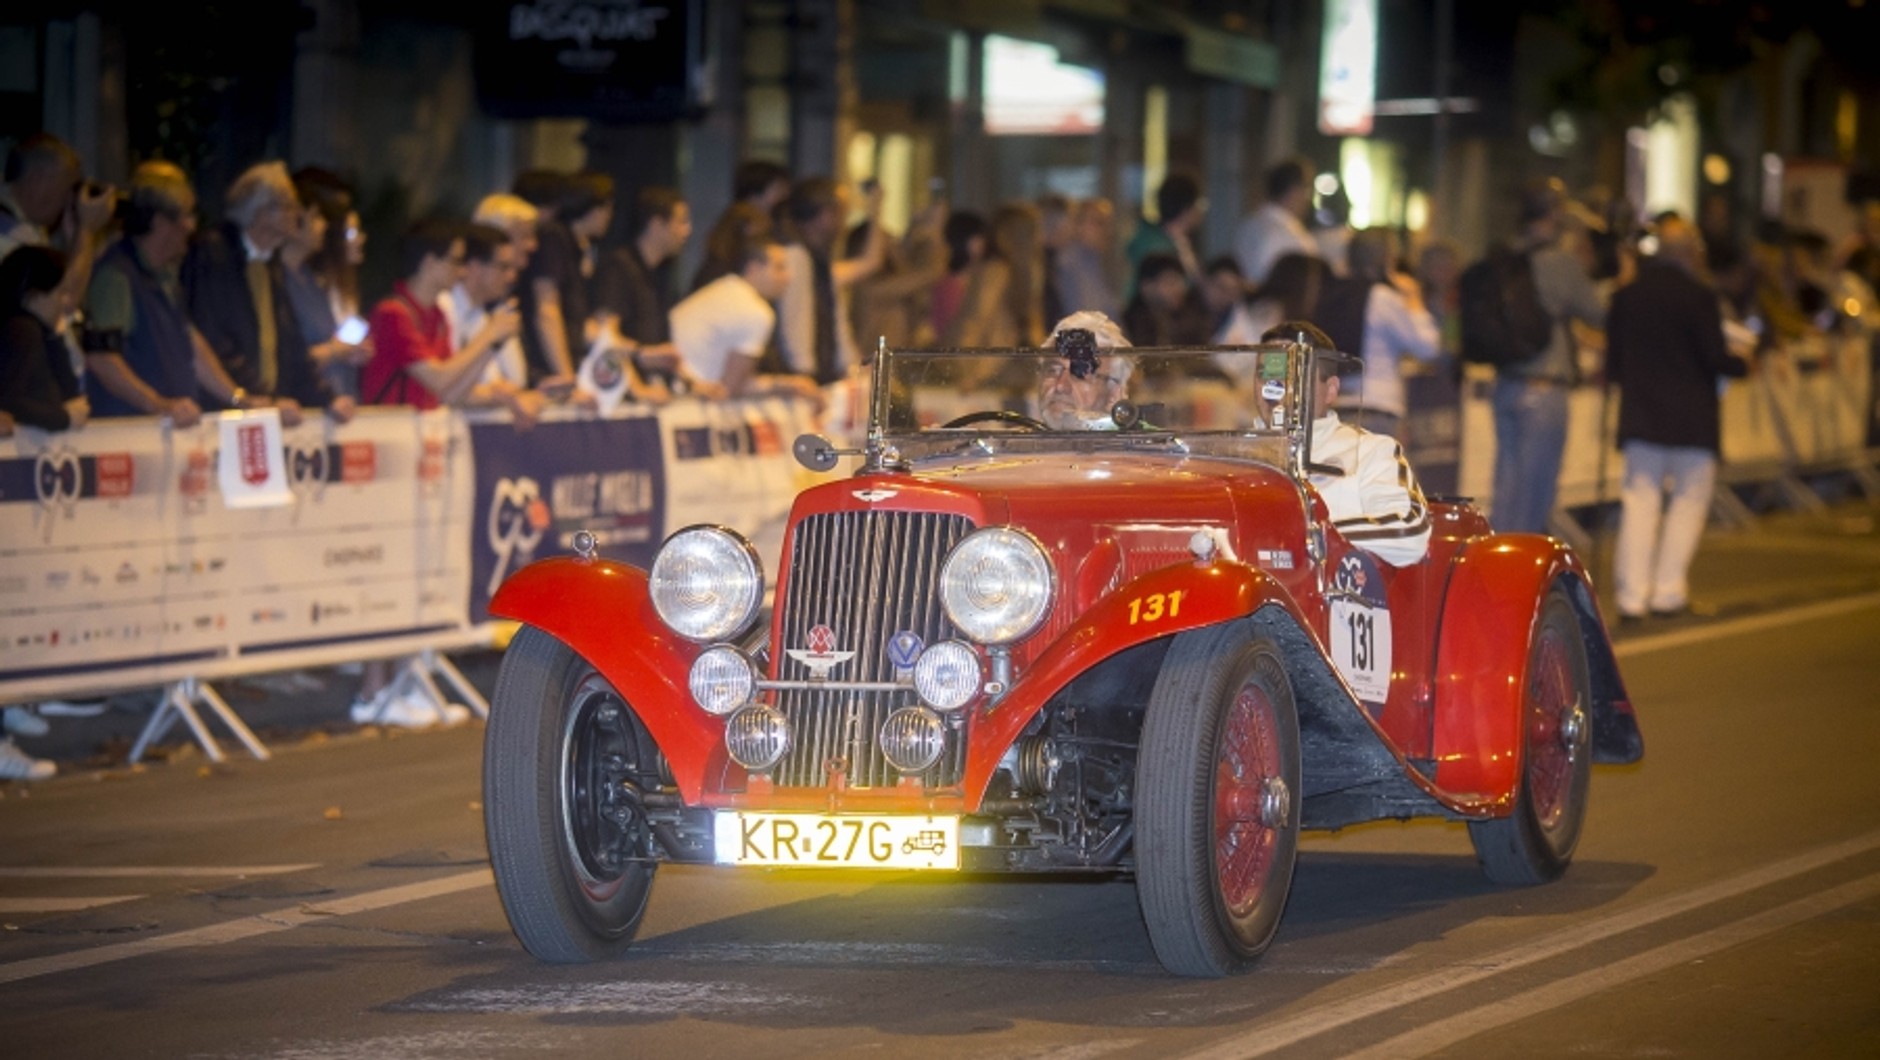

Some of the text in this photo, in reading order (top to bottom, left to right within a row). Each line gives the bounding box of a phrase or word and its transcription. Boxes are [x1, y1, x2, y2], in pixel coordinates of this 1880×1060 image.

[1127, 589, 1182, 625] 131
[1348, 611, 1375, 672] 131
[741, 818, 893, 862] KR 27G
